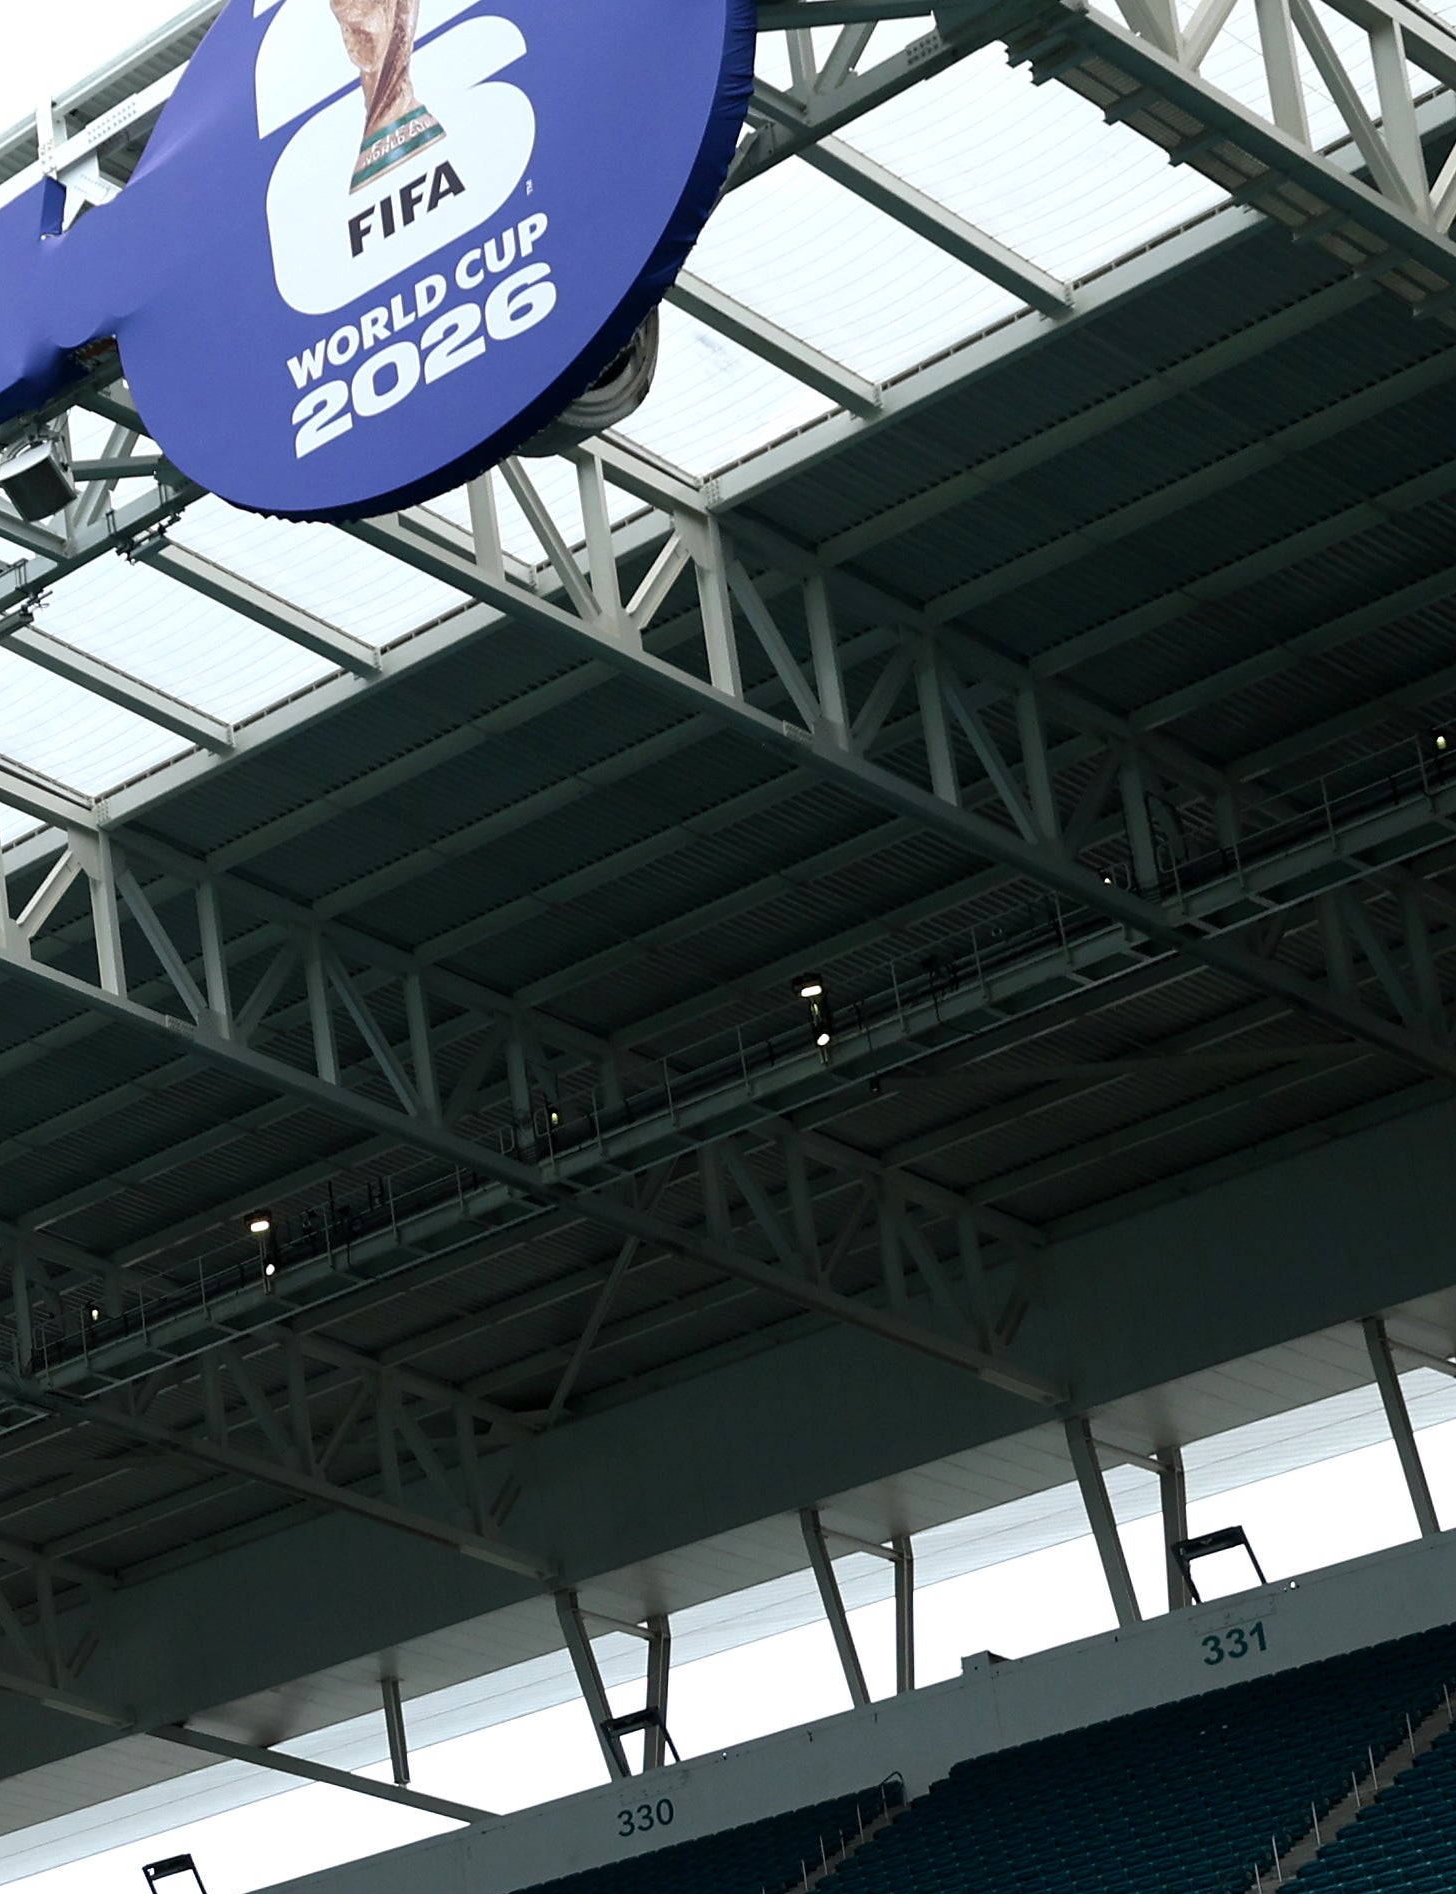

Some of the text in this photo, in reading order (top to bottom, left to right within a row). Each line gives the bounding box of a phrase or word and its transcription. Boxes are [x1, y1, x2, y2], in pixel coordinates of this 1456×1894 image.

[348, 160, 466, 258] FIFA
[286, 212, 548, 389] WORLD CUP
[292, 262, 557, 459] 2026
[1202, 1623, 1267, 1666] 331
[618, 1799, 674, 1837] 330
